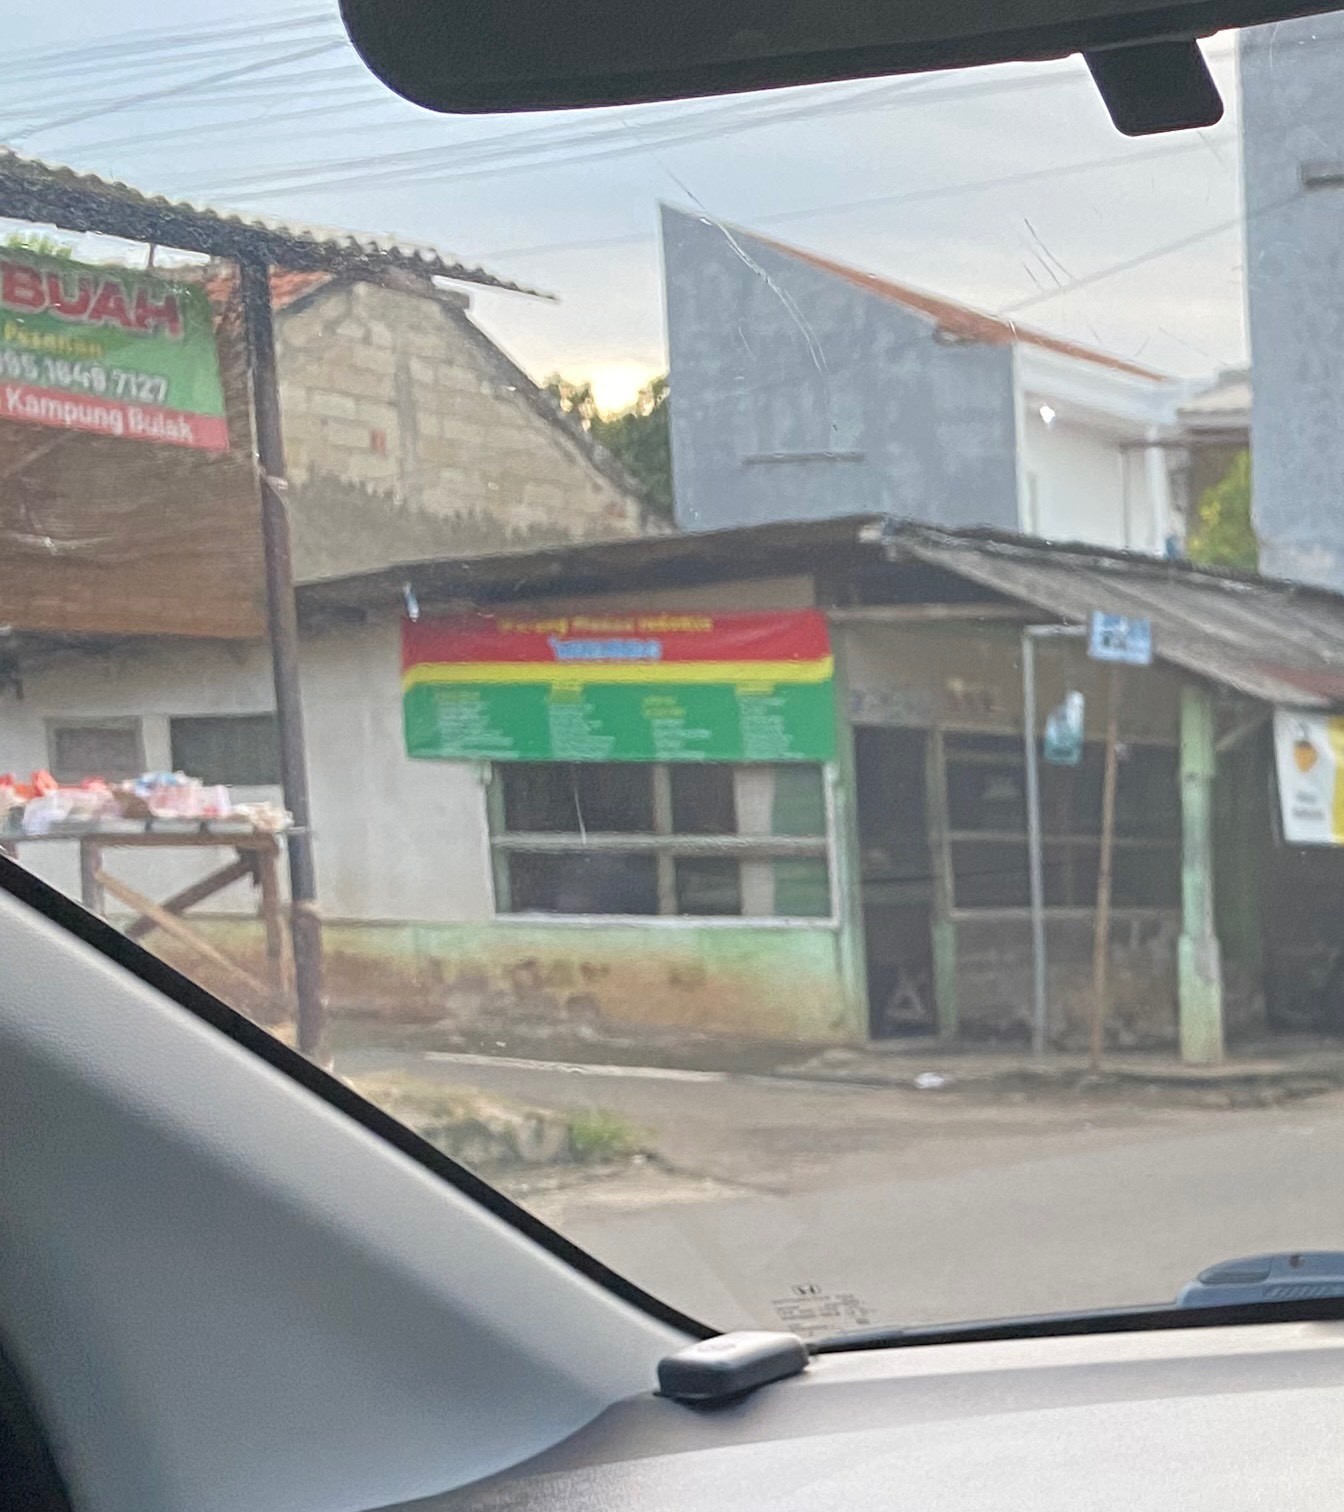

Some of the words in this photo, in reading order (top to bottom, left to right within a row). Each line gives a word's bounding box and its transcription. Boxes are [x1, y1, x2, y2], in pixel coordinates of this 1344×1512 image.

[0, 259, 183, 340] BUAH
[5, 387, 124, 435] Kampung
[128, 405, 193, 442] Bulak
